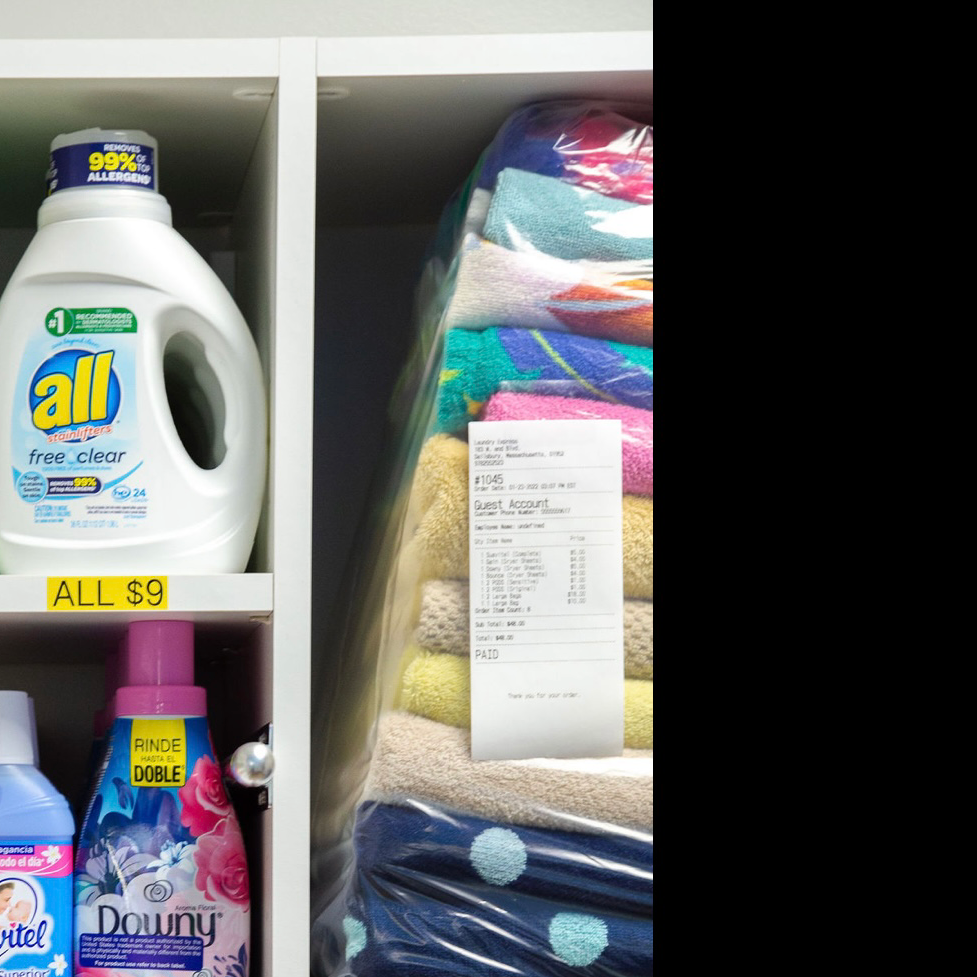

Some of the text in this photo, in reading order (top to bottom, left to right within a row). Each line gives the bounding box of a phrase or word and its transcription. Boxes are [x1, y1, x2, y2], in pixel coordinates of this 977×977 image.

[104, 144, 140, 152] REMOVES
[89, 152, 146, 172] 99% OF
[137, 164, 150, 172] TOP
[48, 310, 65, 333] #1
[32, 350, 115, 430] all
[47, 425, 113, 443] stainlifters
[29, 448, 126, 465] free clear
[74, 477, 97, 487] 99%
[475, 474, 504, 485] #1045
[133, 488, 146, 497] 24
[474, 498, 549, 510] Guest Account
[53, 579, 164, 607] ALL $9
[475, 649, 499, 659] PAID
[135, 738, 181, 752] RINDE
[134, 765, 180, 782] DOBLE
[18, 858, 26, 867] el
